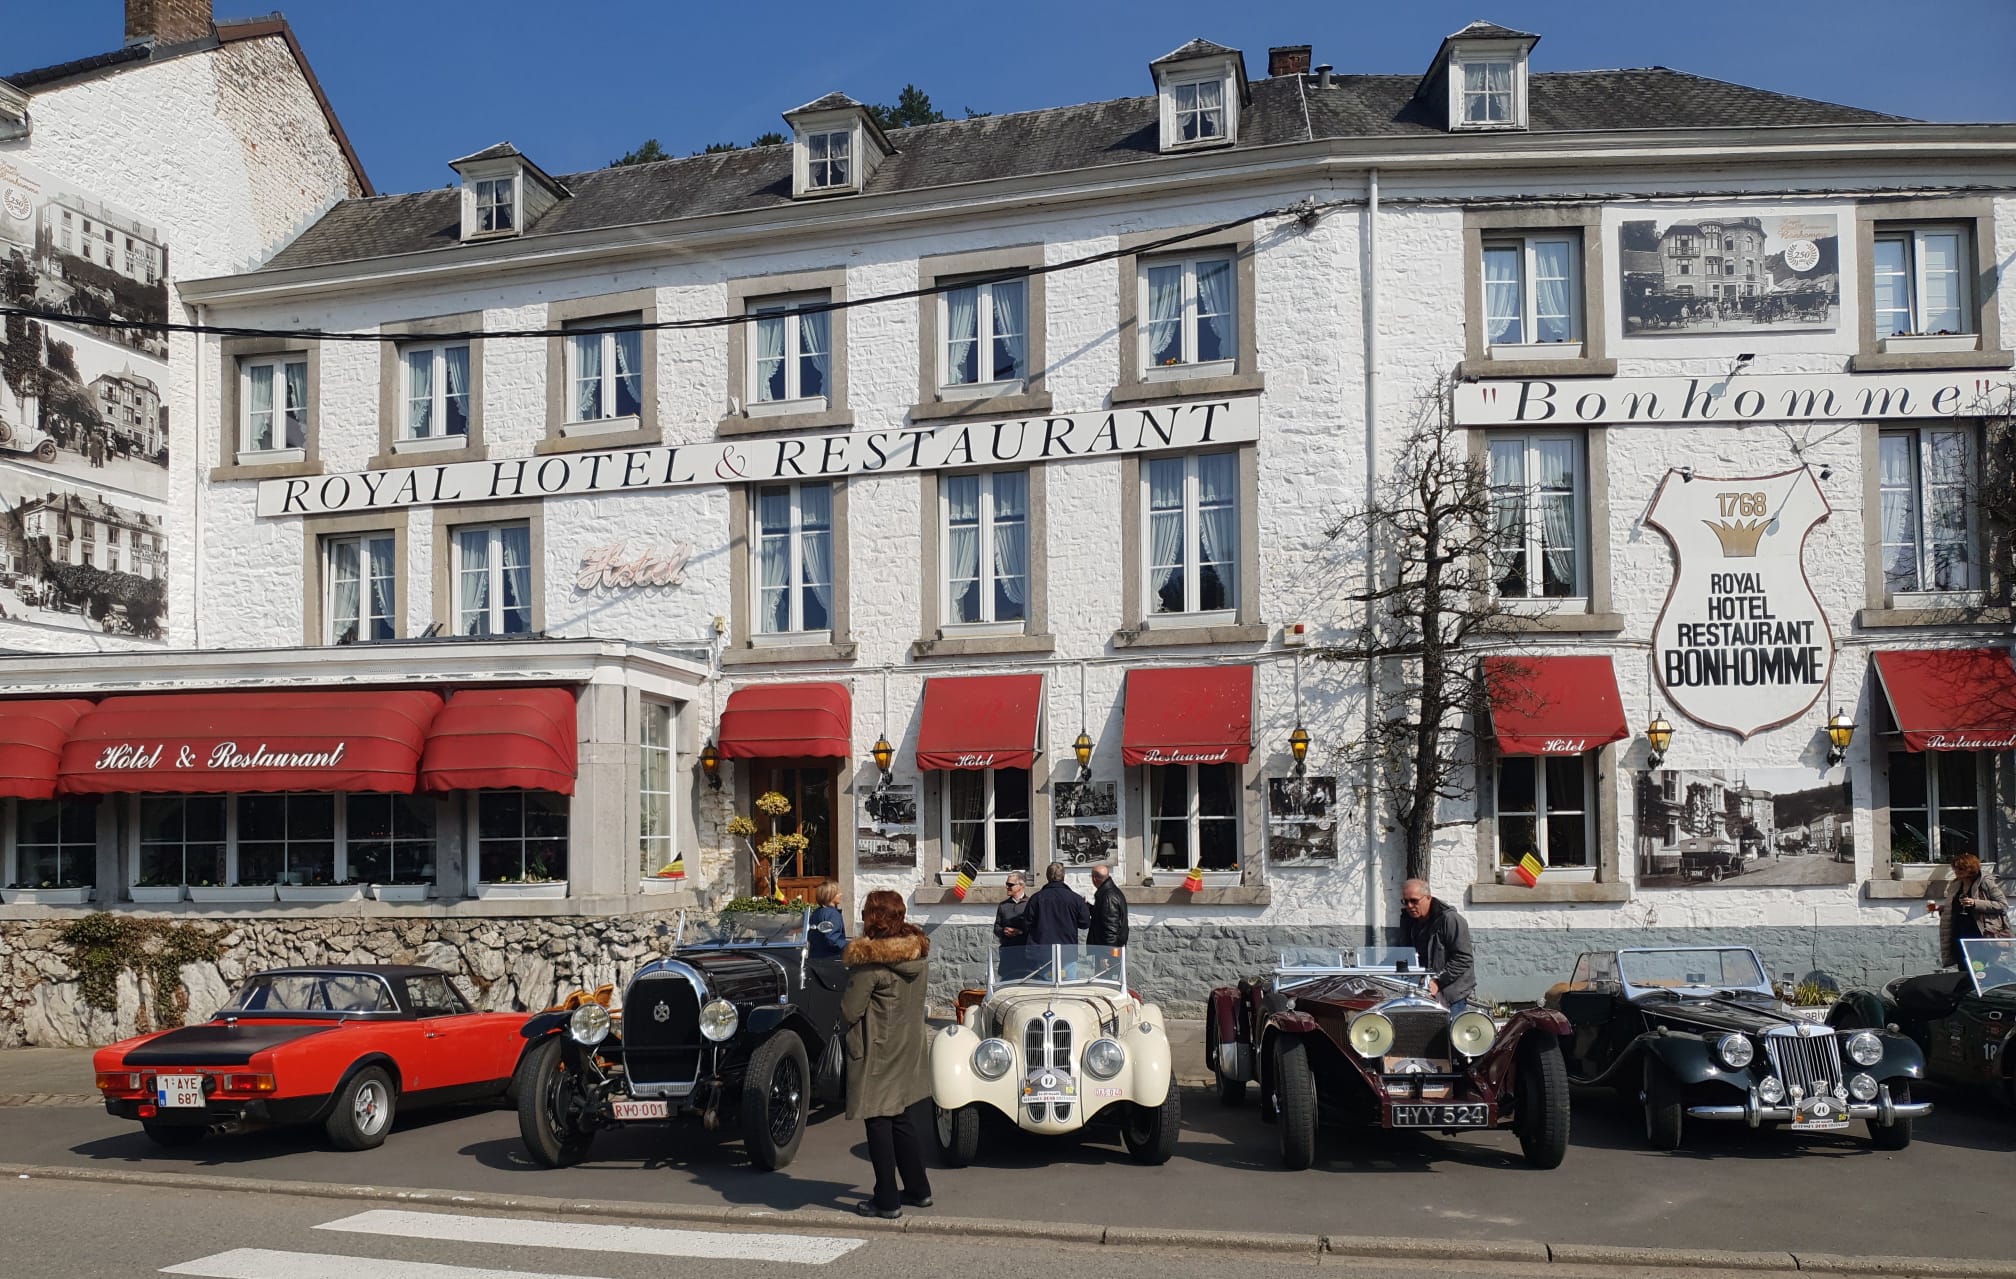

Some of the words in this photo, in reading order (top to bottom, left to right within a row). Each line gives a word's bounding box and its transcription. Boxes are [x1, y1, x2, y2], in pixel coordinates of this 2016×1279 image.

[1793, 251, 1810, 259] 250
[281, 466, 461, 513] ROYAL
[489, 447, 695, 498] HOTEL
[715, 445, 750, 480] &
[773, 402, 1230, 478] RESTAURANT
[1715, 492, 1767, 517] 1768
[1710, 572, 1766, 595] ROYAL
[1708, 596, 1776, 621] HOTEL
[1677, 621, 1815, 648] RESTAURANT
[1664, 647, 1824, 688] BONHOMME
[95, 743, 164, 770] Hôtel
[175, 744, 196, 769] &
[207, 741, 346, 769] Restaurant
[1143, 748, 1229, 762] Restaurant
[178, 1093, 198, 1105] 687
[1396, 1106, 1437, 1125] HYY
[1442, 1106, 1484, 1125] 524
